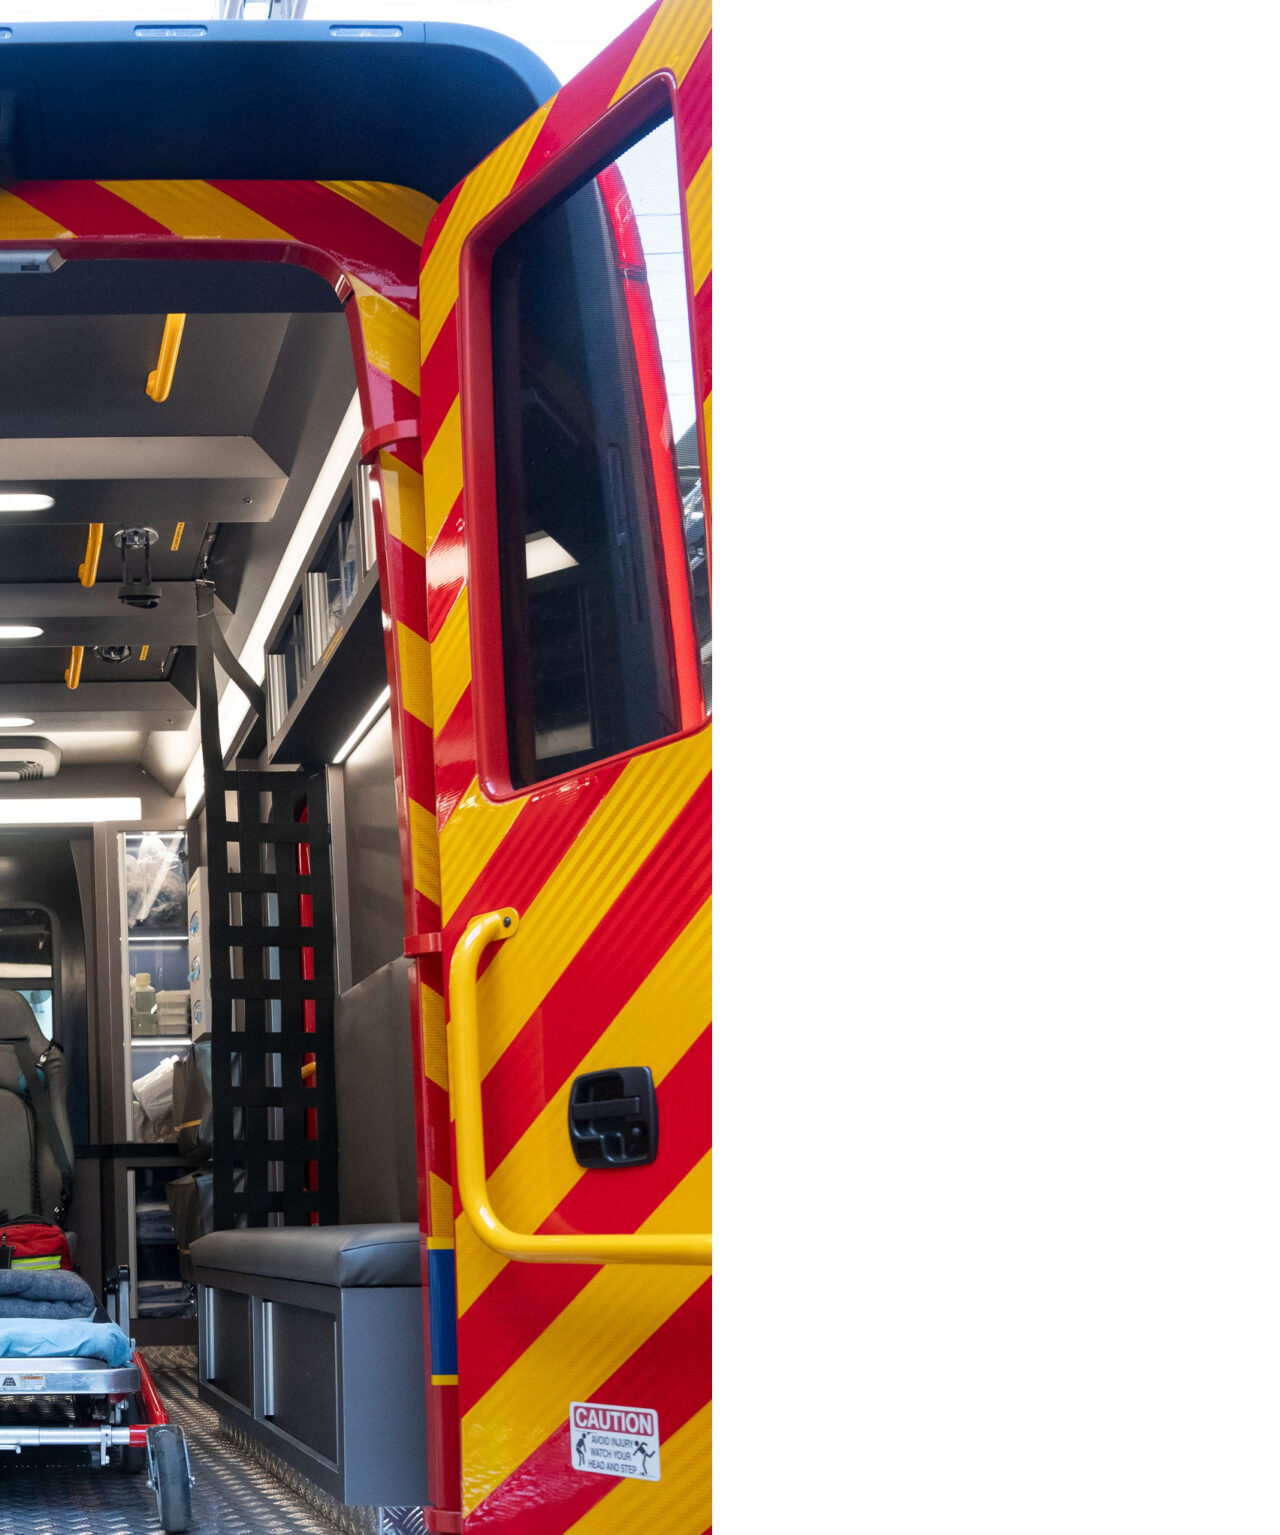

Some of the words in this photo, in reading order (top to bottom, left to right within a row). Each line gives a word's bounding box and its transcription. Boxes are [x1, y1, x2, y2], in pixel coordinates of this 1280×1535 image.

[575, 1408, 652, 1435] CAUTION
[591, 1435, 610, 1446] AVOID
[611, 1438, 633, 1448] INJURY
[590, 1447, 612, 1458] WATCH
[613, 1450, 631, 1461] YOUR
[588, 1460, 605, 1470] HEAD
[606, 1462, 620, 1472] AND
[620, 1464, 637, 1475] STEP
